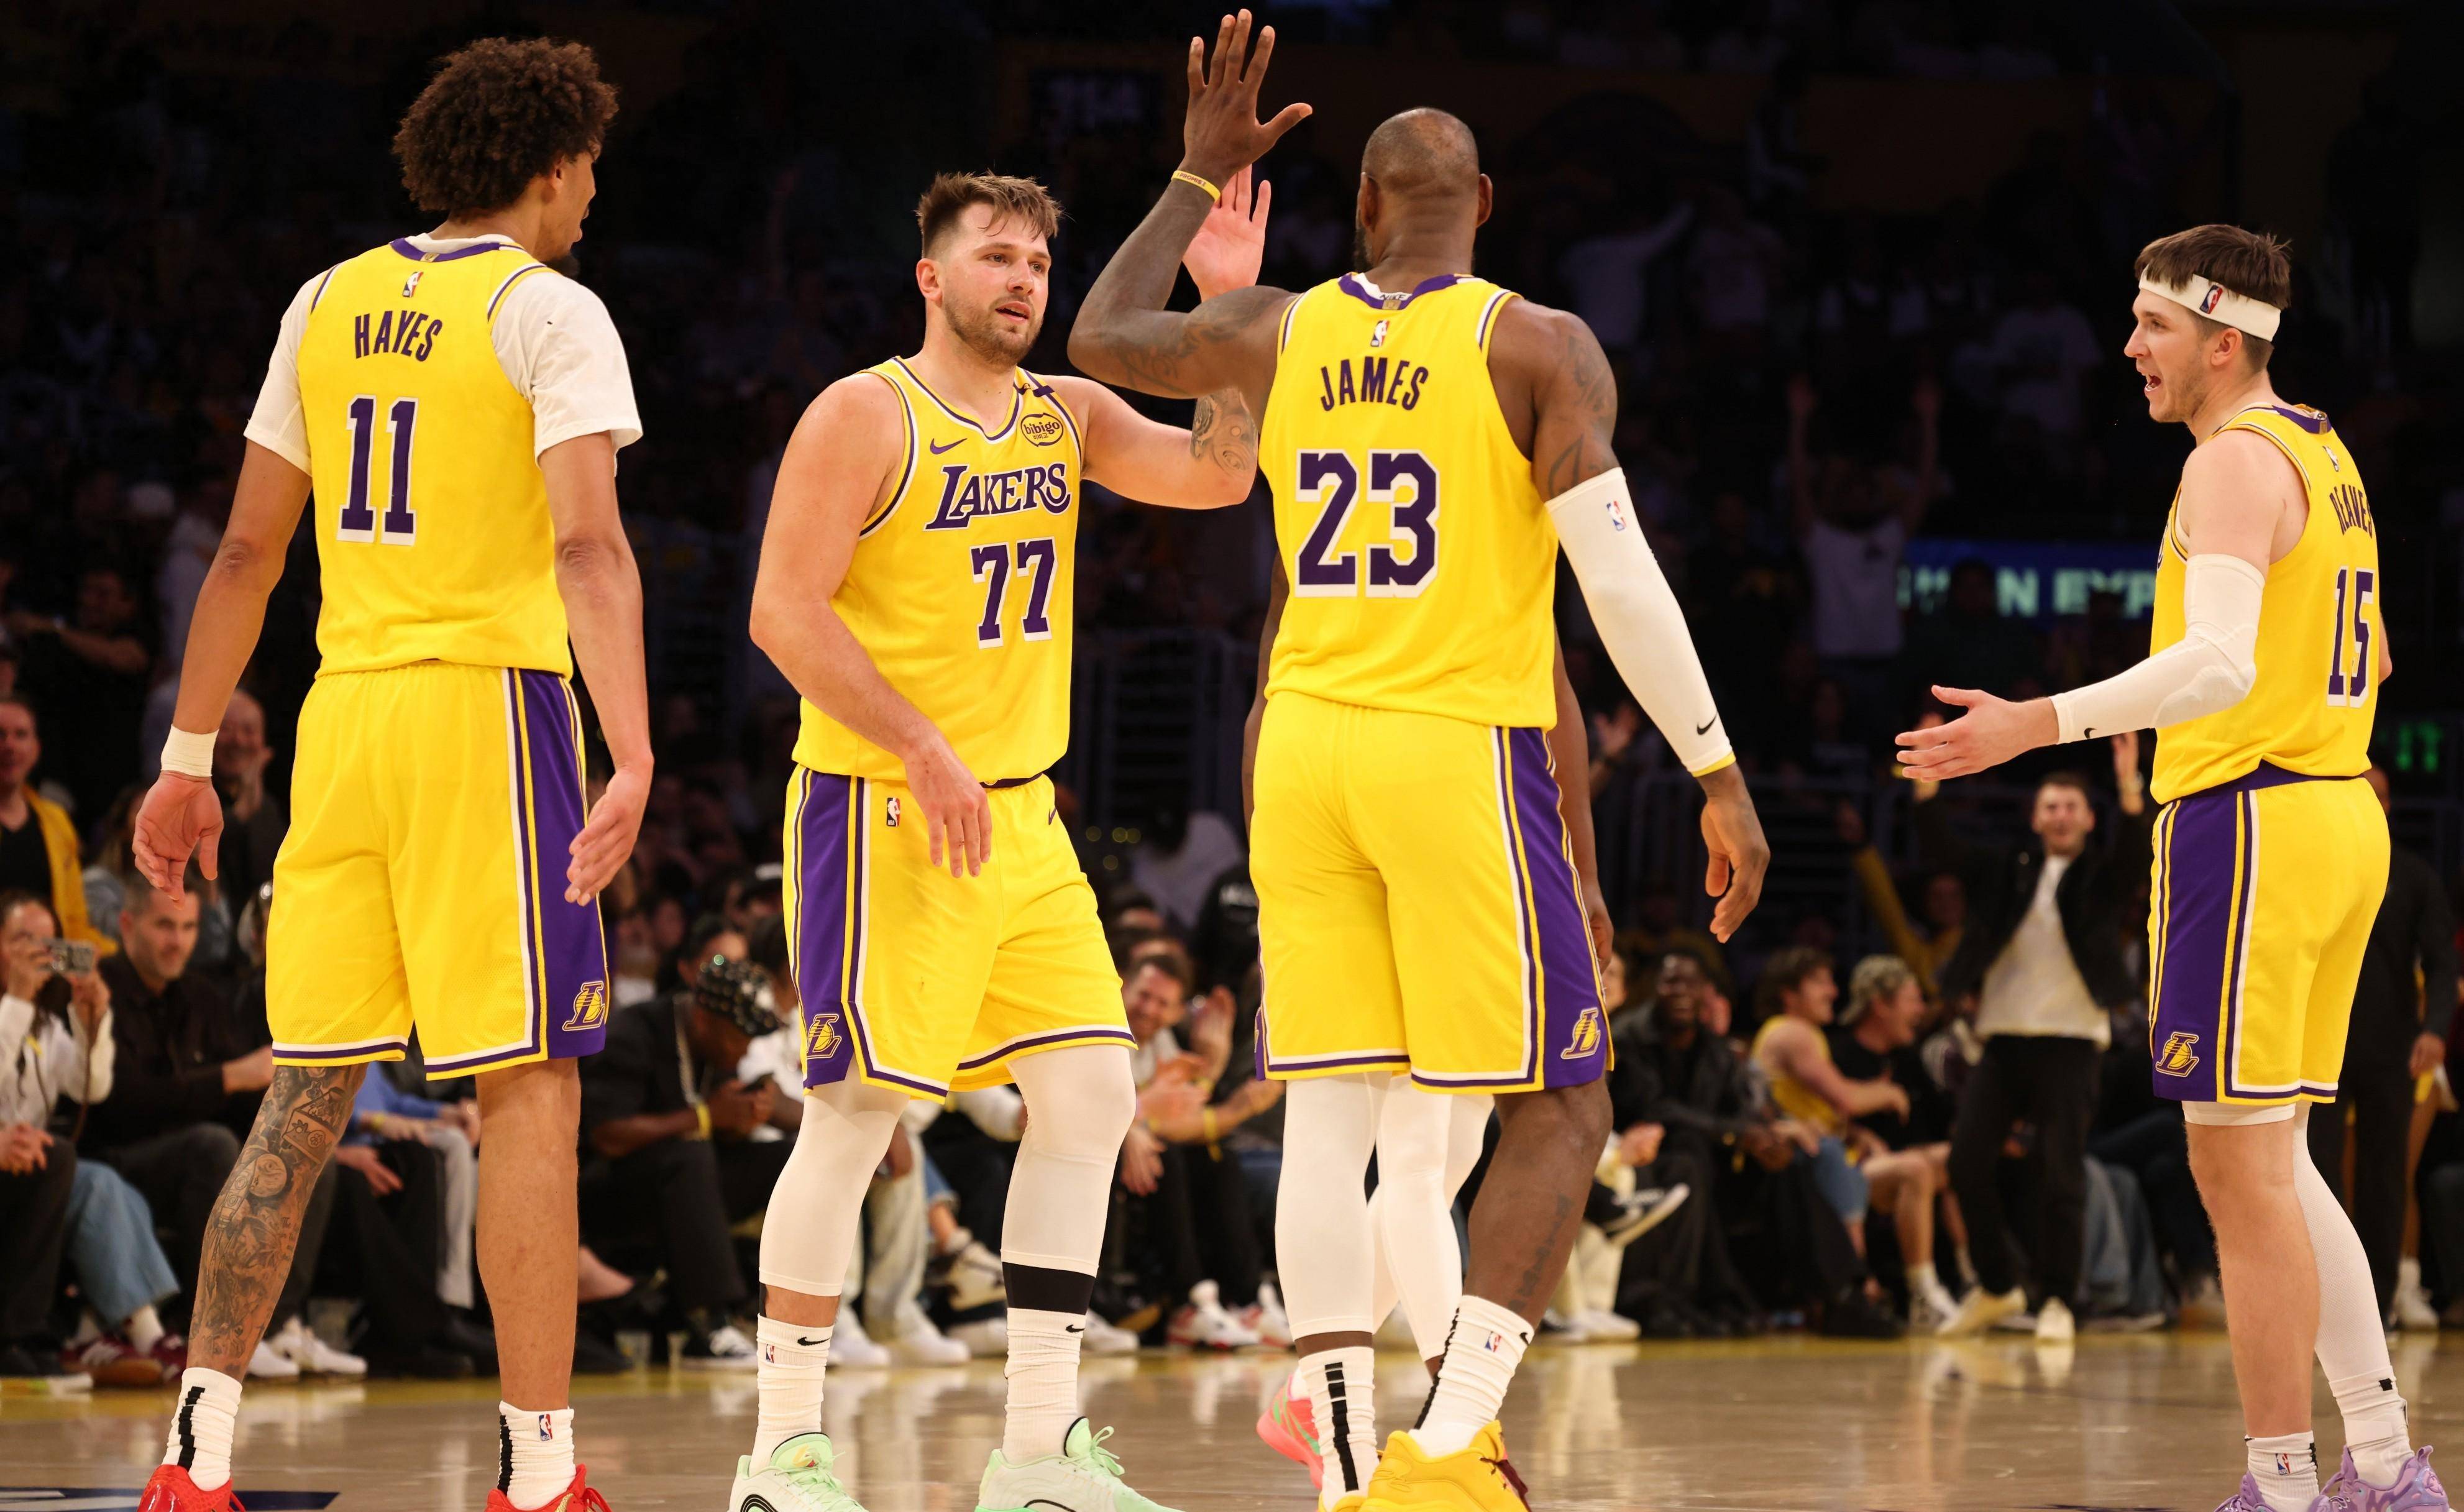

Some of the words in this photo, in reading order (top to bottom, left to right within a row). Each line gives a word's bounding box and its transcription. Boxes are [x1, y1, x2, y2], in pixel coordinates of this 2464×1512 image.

[354, 310, 443, 362] HAYES
[1024, 422, 1060, 434] bibigo
[1320, 356, 1429, 411] JAMES
[336, 393, 419, 546] 11
[923, 462, 1072, 531] LAKERS
[1294, 448, 1440, 598] 23
[969, 536, 1058, 649] 77
[2326, 565, 2374, 708] 15
